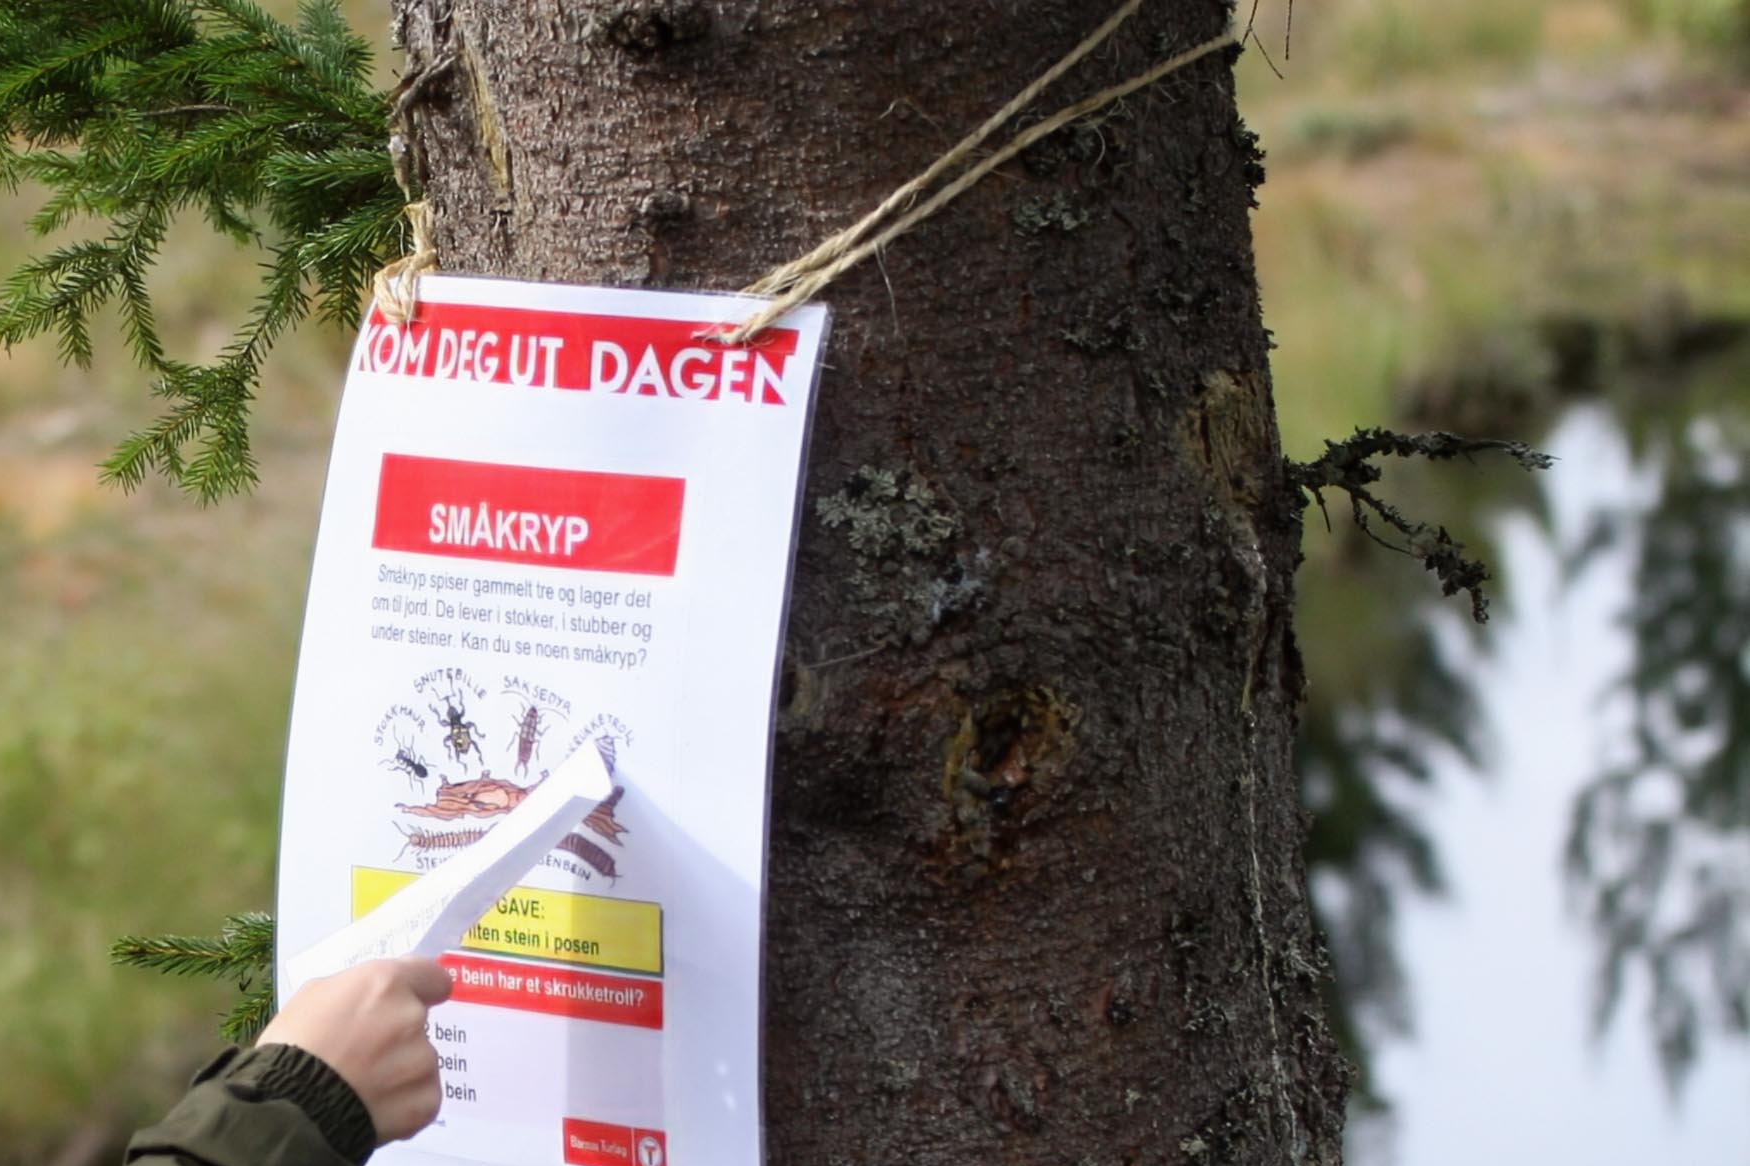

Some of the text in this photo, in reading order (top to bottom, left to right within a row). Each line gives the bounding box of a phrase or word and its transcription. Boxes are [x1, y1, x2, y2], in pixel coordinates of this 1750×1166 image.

[356, 323, 796, 406] KOM DEG UT DAGEN
[428, 501, 589, 556] SMÅKRYP
[378, 563, 652, 610] Småkryp spiser gammelt tre og lager det
[371, 596, 390, 611] om
[392, 594, 402, 613] til
[403, 596, 431, 619] jord.
[435, 598, 455, 619] De
[458, 601, 492, 623] lever
[504, 608, 559, 632] stokker,
[569, 614, 627, 636] stubber
[631, 621, 652, 643] og
[371, 624, 405, 642] under
[461, 630, 489, 651] Kan
[493, 634, 511, 654] du
[514, 640, 531, 656] se
[535, 642, 570, 660] noen
[573, 644, 647, 671] småkryp?
[495, 896, 545, 919] GAVE:
[504, 927, 540, 948] stein
[553, 936, 600, 956] posen
[461, 964, 494, 987] bein
[497, 969, 523, 991] har
[525, 975, 541, 994] et
[543, 977, 644, 1007] skrukketroll?
[435, 1021, 467, 1043] bein
[445, 1080, 477, 1103] bein
